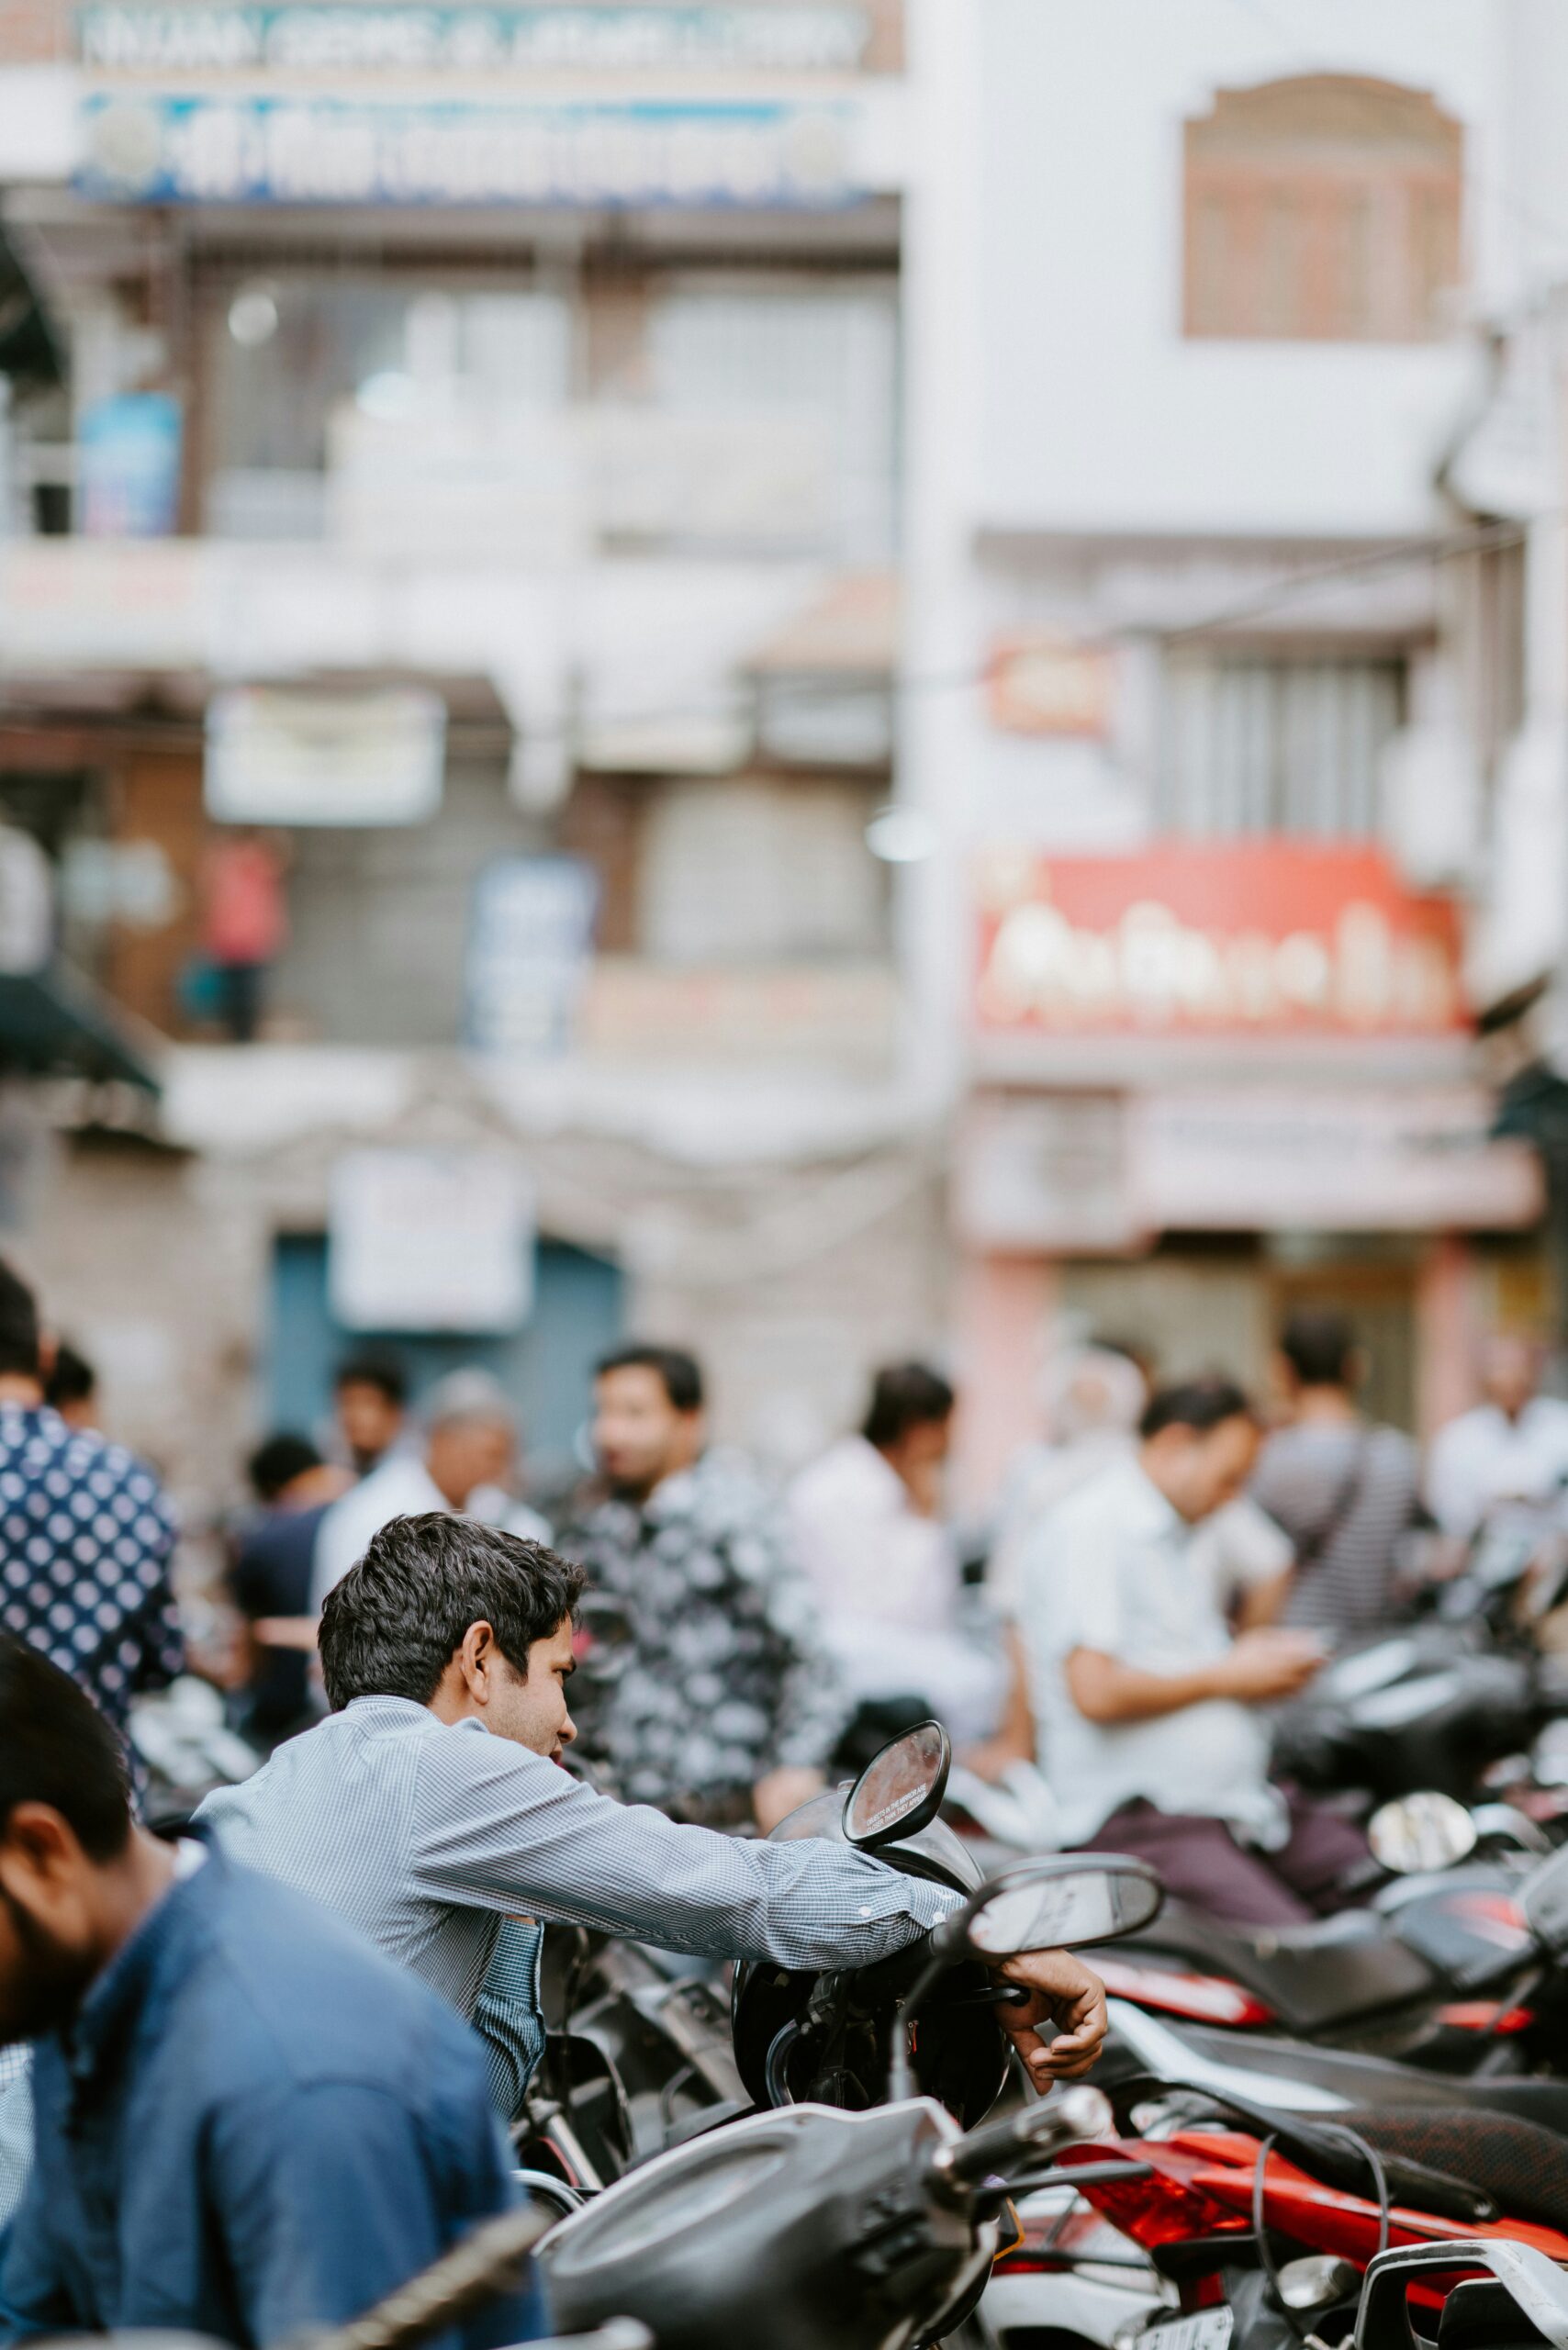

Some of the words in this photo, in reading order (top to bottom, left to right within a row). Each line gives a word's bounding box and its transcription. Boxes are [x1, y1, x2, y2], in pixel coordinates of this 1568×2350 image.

[867, 1808, 886, 1826] OBJECTS
[890, 1799, 900, 1810] THE
[900, 1789, 917, 1804] MIRROR
[917, 1783, 926, 1793] ARE
[868, 1818, 884, 1834] CLOSER
[884, 1811, 897, 1822] THAN
[897, 1803, 908, 1814] THEY
